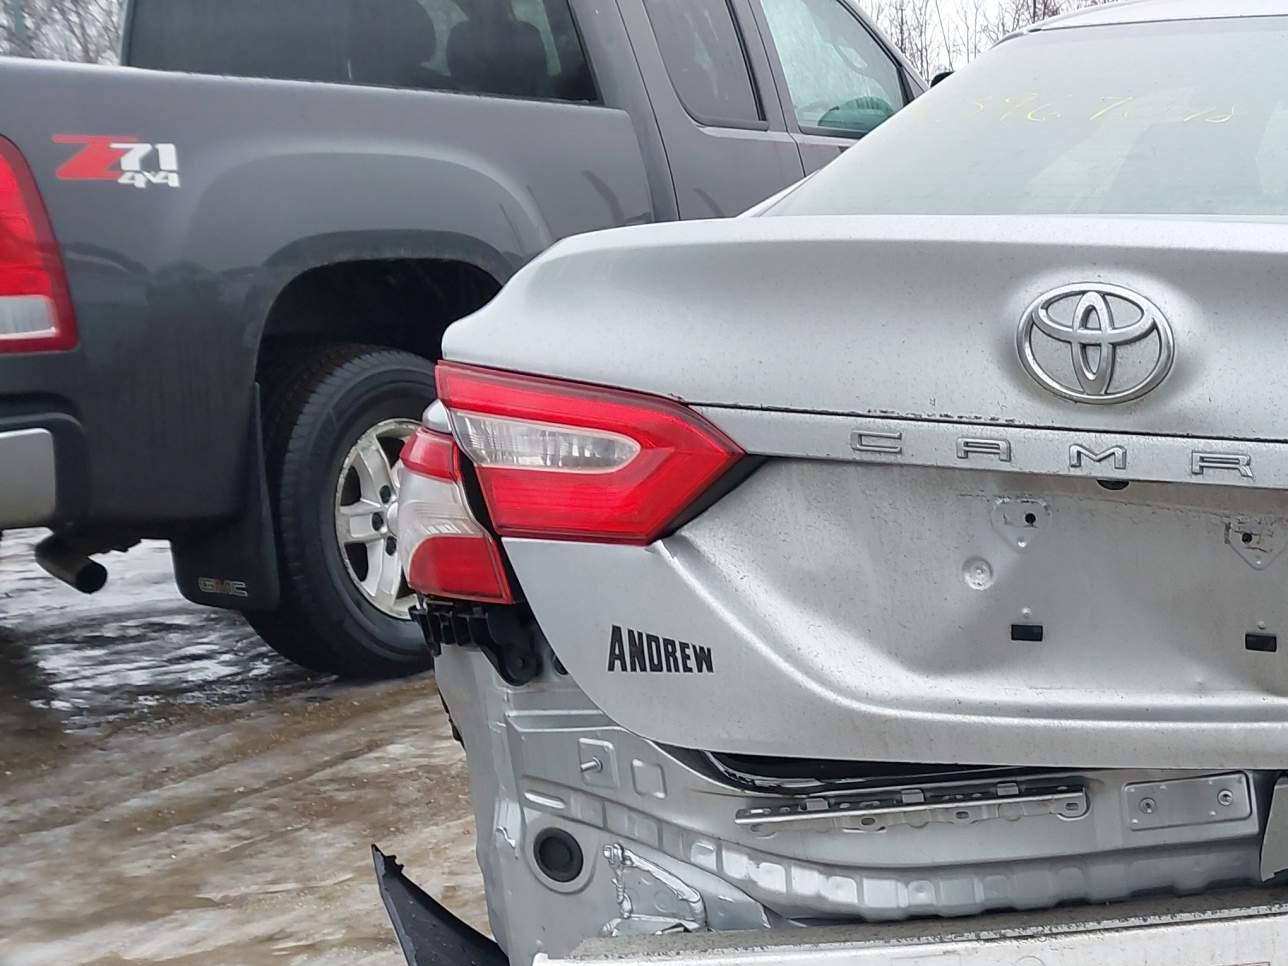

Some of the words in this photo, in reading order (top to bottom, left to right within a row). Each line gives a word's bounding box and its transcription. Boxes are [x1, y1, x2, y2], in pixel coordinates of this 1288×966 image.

[52, 134, 178, 181] Z71
[198, 577, 248, 597] GMC
[607, 624, 714, 673] ANDREW
